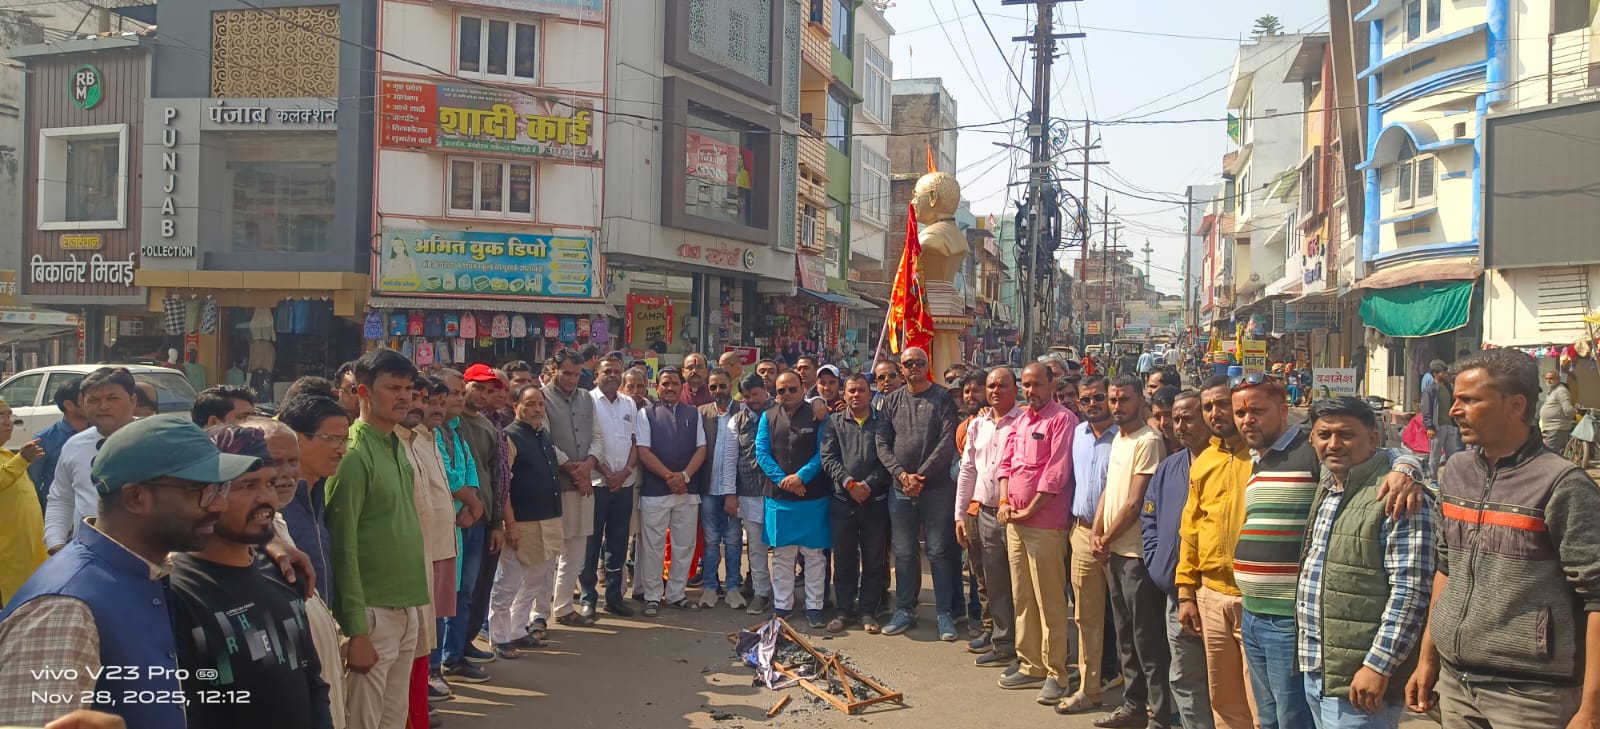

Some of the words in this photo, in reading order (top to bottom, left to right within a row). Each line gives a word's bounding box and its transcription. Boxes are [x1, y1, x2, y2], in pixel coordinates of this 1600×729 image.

[76, 72, 95, 85] RB
[76, 86, 87, 100] M
[208, 100, 269, 124] पंजाब
[275, 107, 337, 124] कलेक्शन
[439, 103, 520, 141] शादी
[525, 109, 591, 147] कार्ड
[162, 106, 178, 239] PUNJAB
[63, 236, 100, 249] राजस्थान
[140, 246, 194, 258] COLLECTION
[414, 233, 467, 254] अमित
[469, 240, 505, 262] बुक
[508, 236, 548, 259] डिपो
[31, 254, 86, 284] बिकानेर
[90, 252, 135, 287] मिठाई
[637, 312, 667, 321] CAMPU
